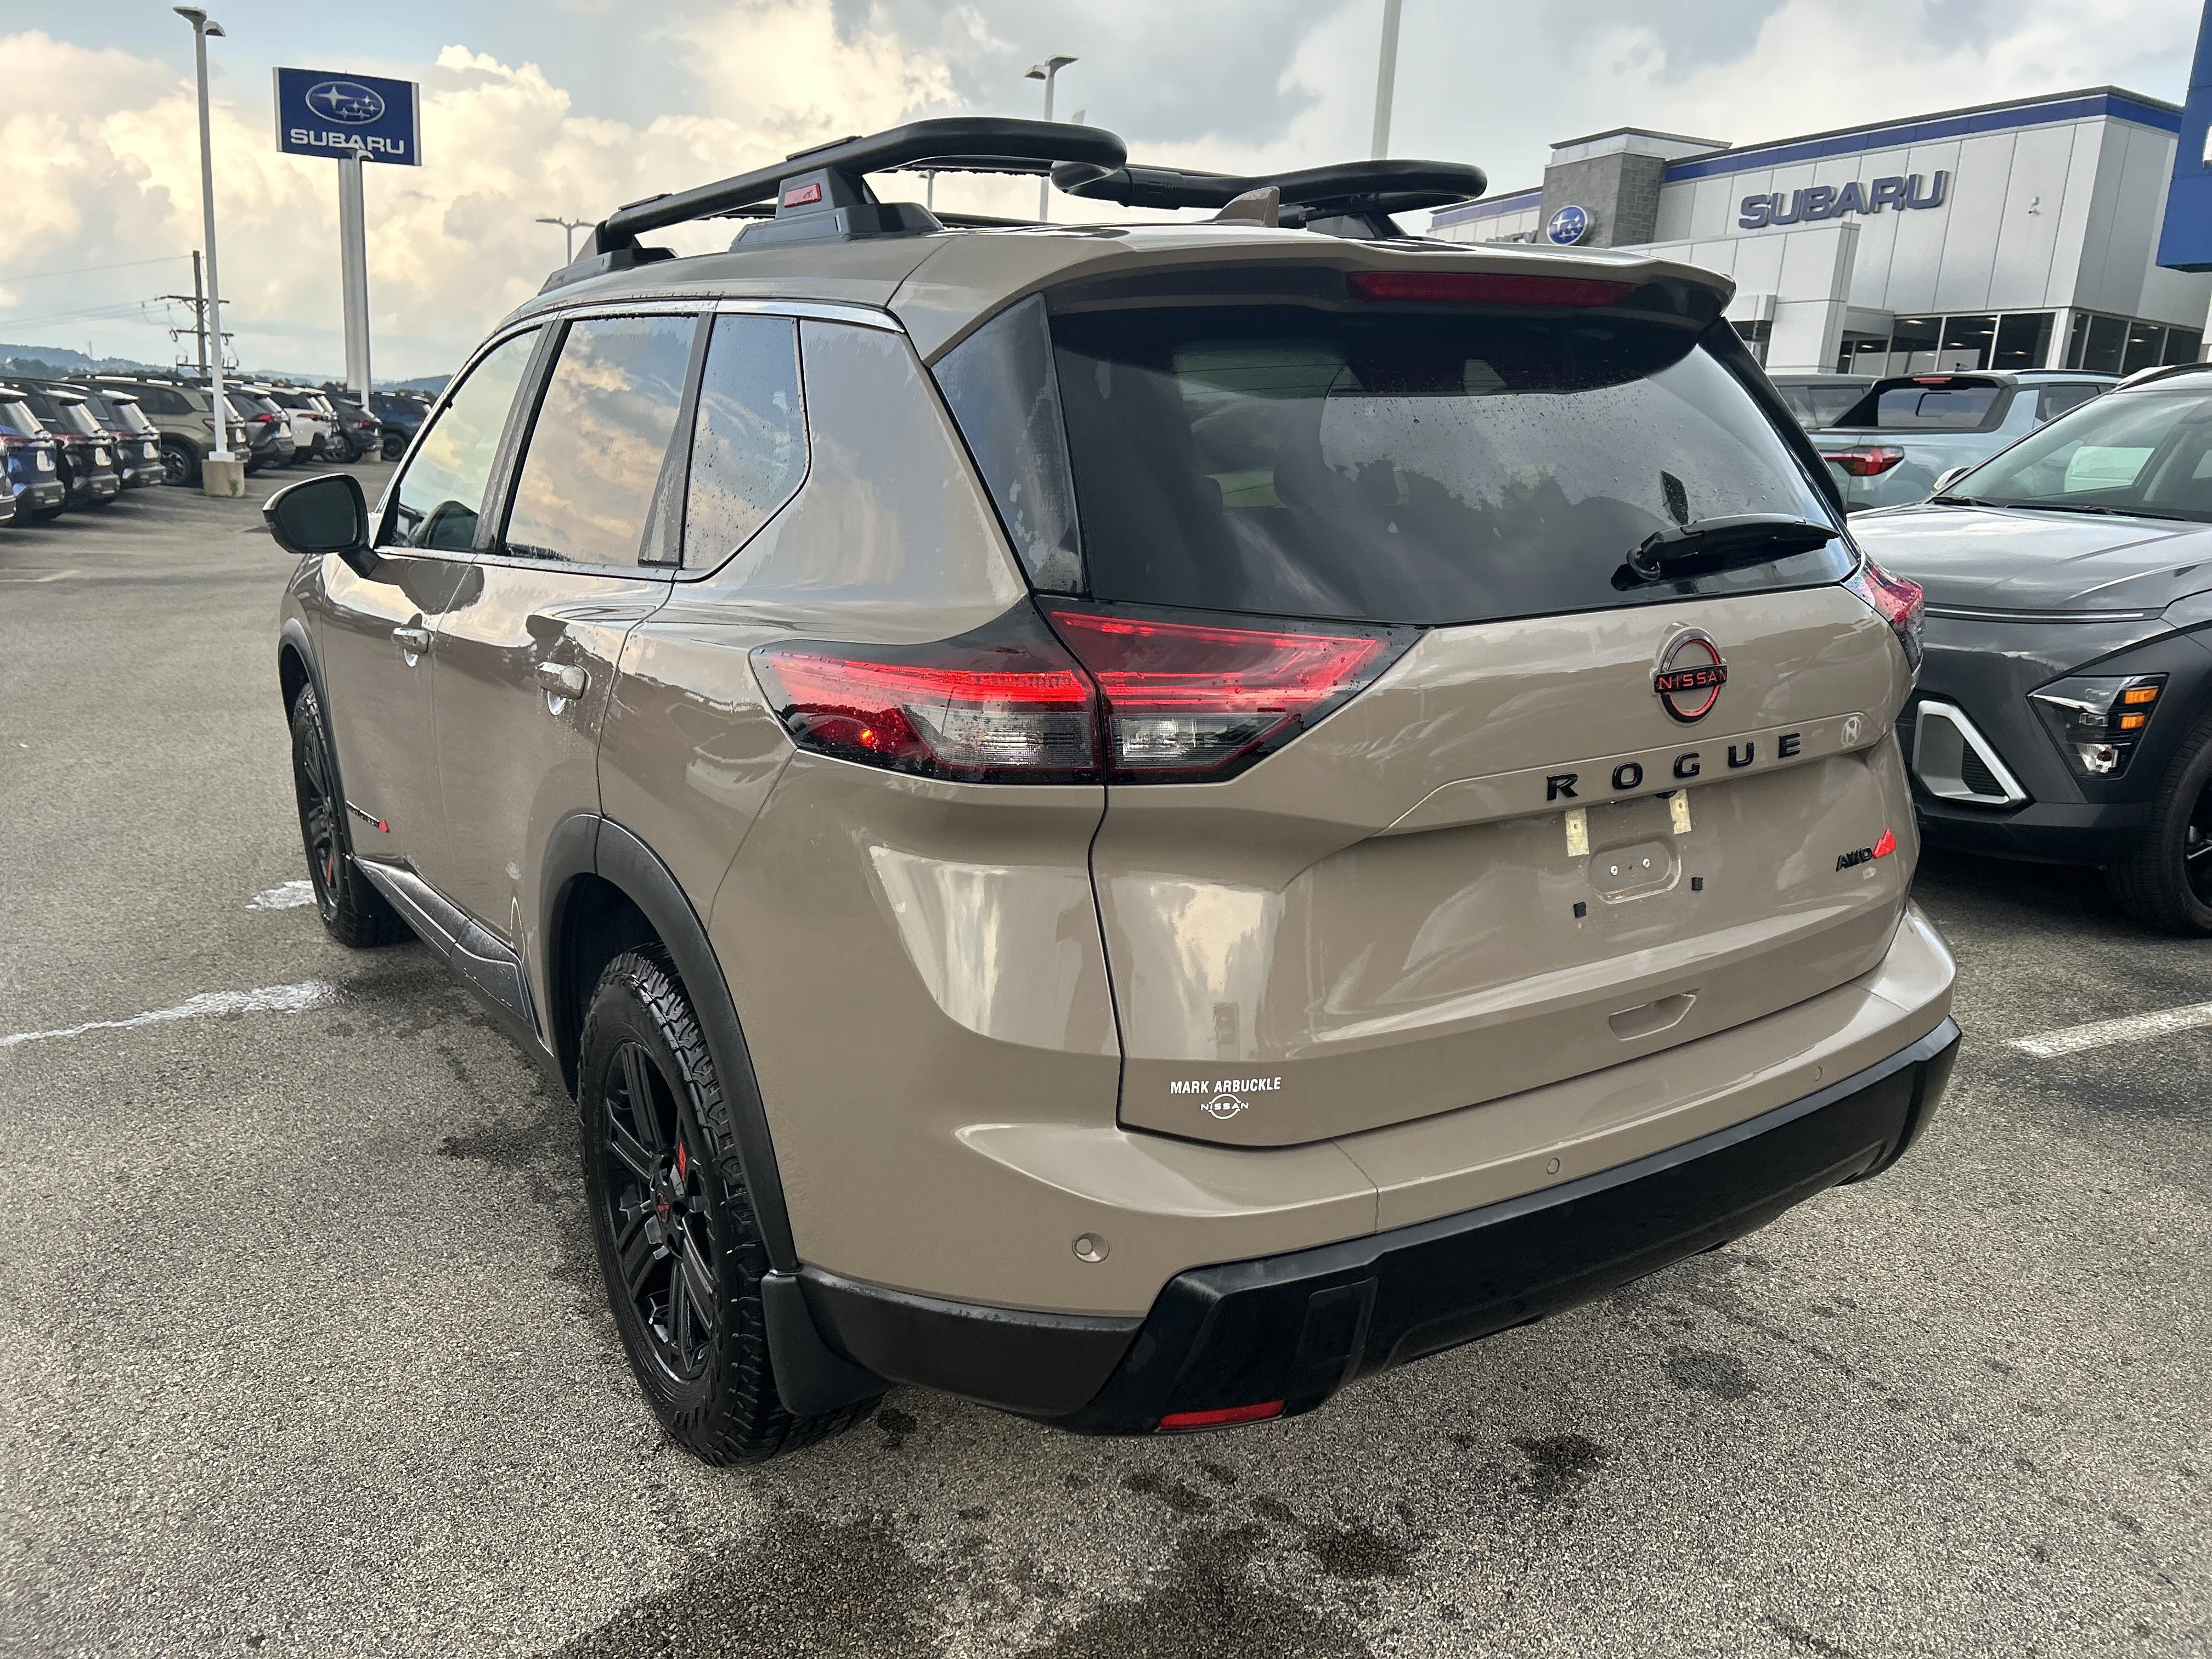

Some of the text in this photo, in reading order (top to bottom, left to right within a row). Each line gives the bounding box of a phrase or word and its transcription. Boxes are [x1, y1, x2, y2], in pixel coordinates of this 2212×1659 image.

[290, 128, 404, 155] SUBARU
[1739, 170, 1950, 229] SUBARU
[1658, 669, 1727, 690] NISSAN
[1547, 732, 1801, 801] ROGUE
[1835, 846, 1872, 872] AWD
[1170, 1076, 1282, 1094] MARK ARBUCKLE
[1200, 1102, 1249, 1111] NISSAN
